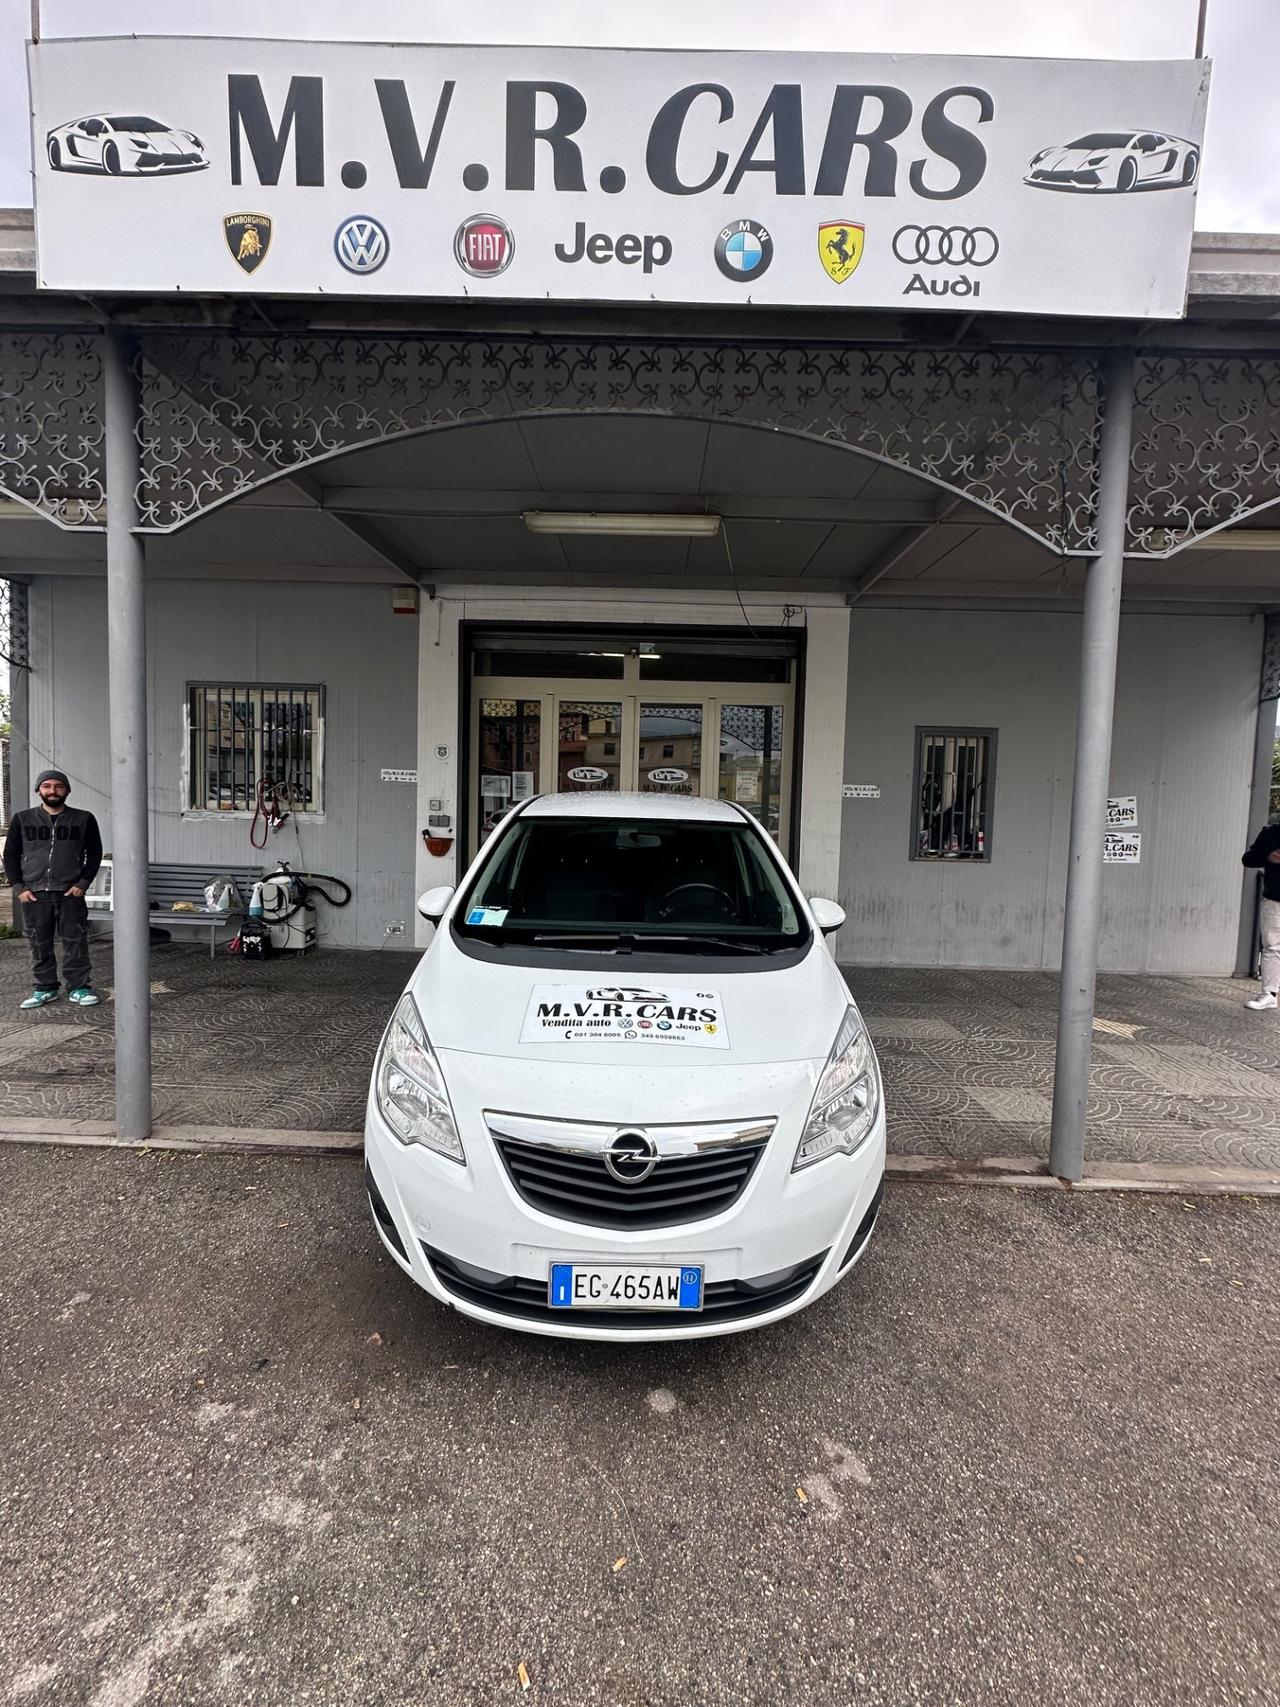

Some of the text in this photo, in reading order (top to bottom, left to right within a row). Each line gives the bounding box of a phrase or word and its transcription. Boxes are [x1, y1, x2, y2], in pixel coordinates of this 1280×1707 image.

[226, 215, 270, 227] LAMBORGHINI
[720, 220, 769, 241] BMW
[469, 233, 502, 261] FIAT
[555, 222, 672, 274] Jeep
[902, 273, 981, 297] Audi
[542, 1019, 583, 1027] Vendita
[586, 1019, 611, 1027] auto
[676, 1023, 702, 1031] Jeep
